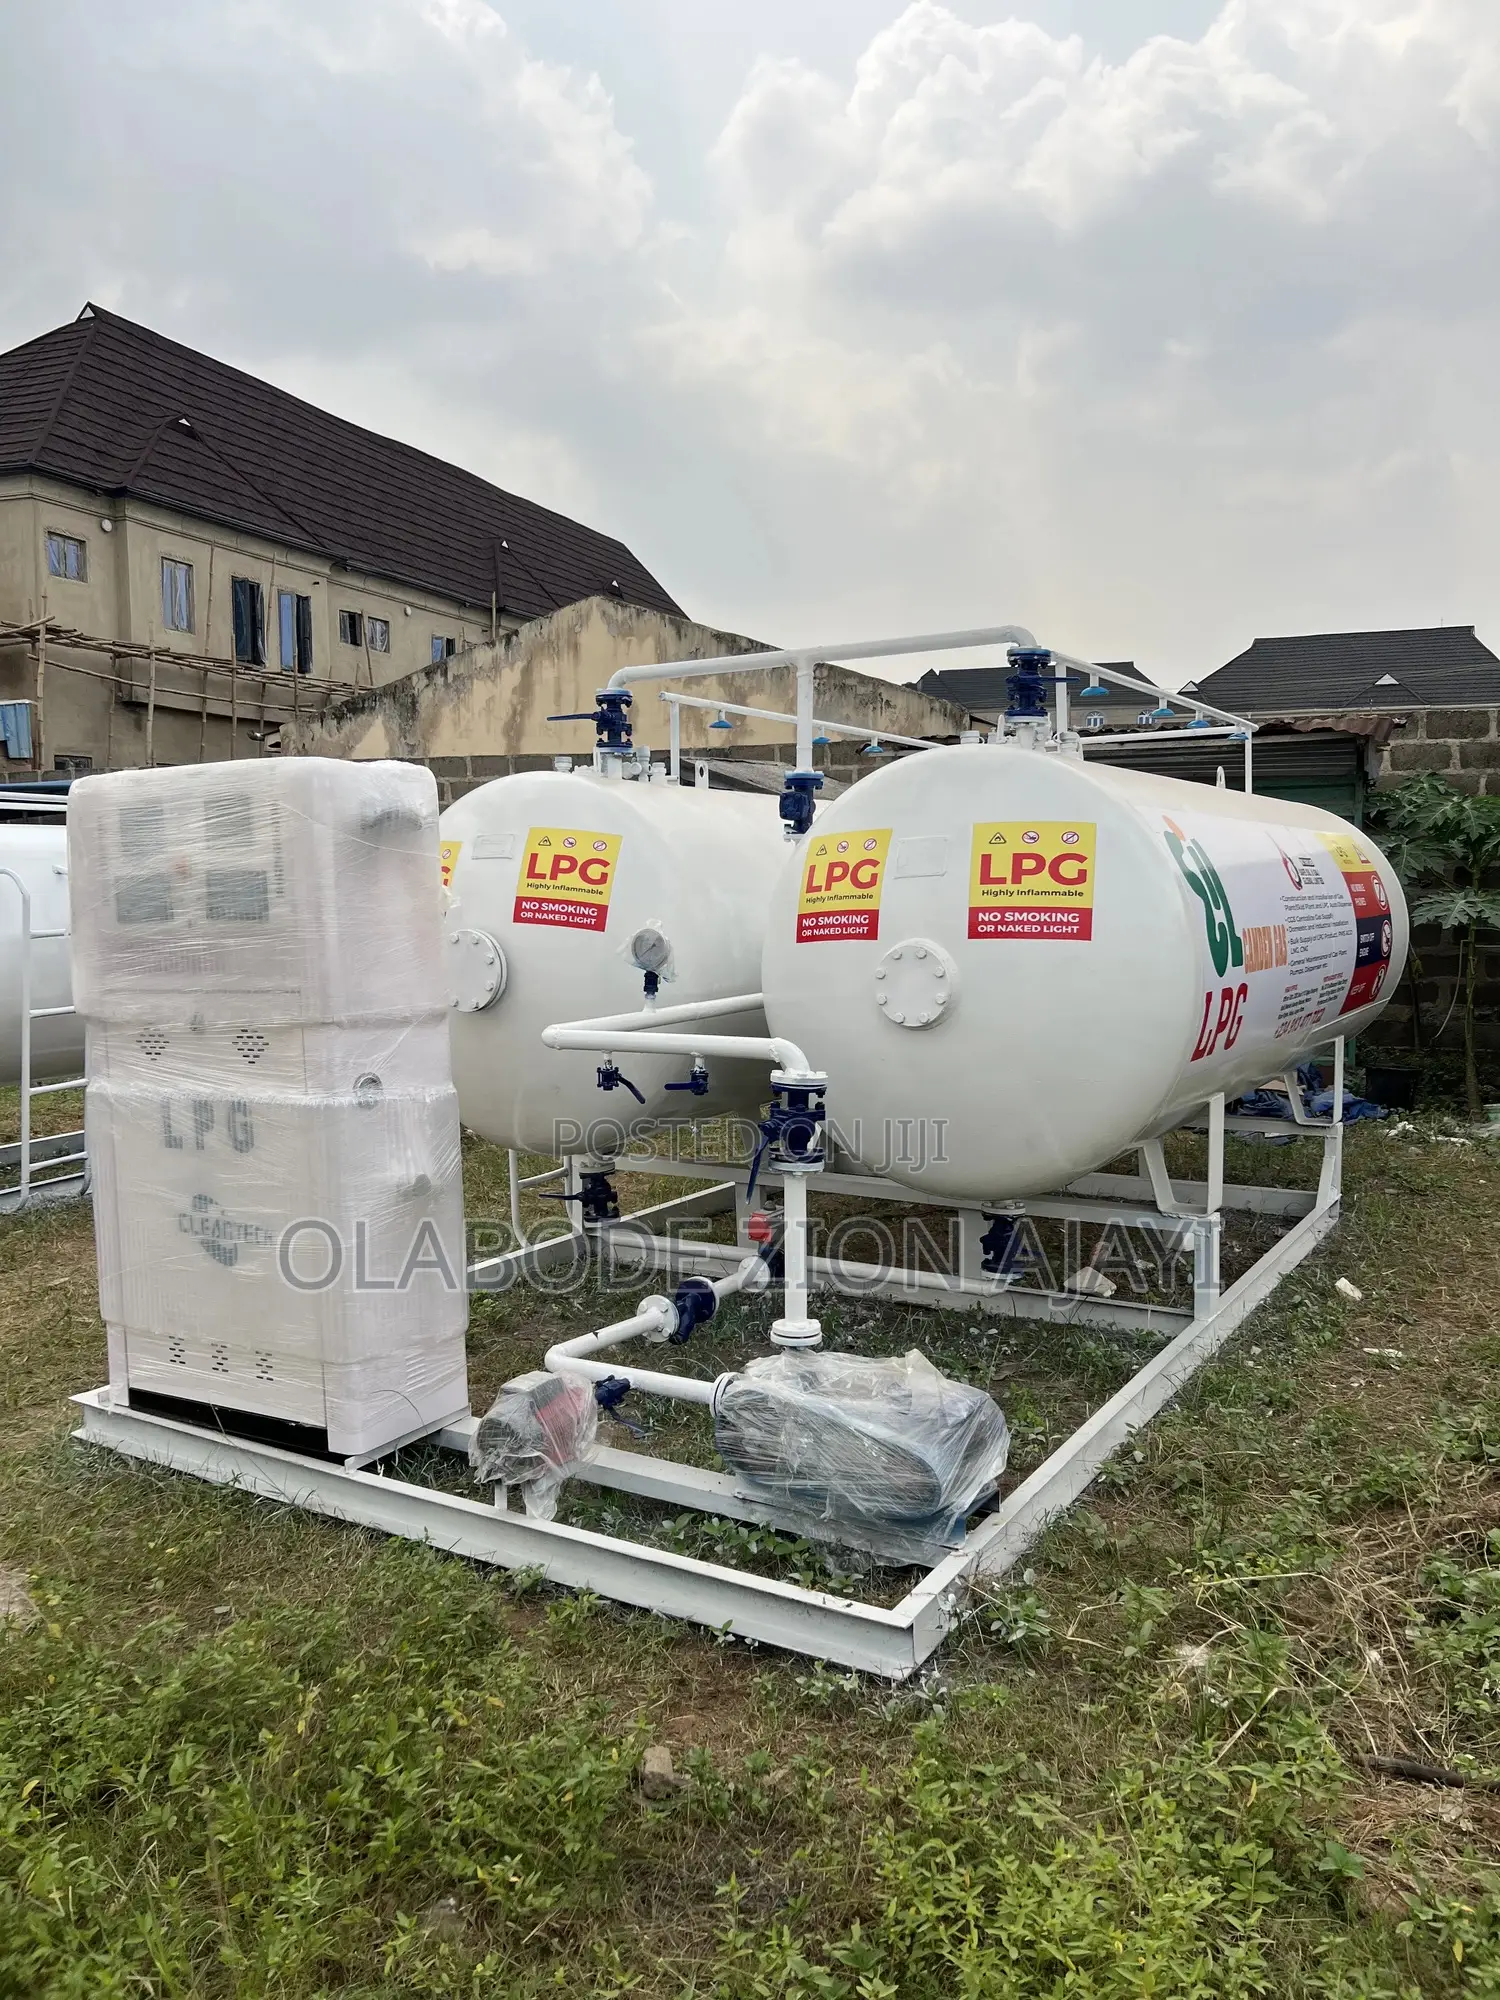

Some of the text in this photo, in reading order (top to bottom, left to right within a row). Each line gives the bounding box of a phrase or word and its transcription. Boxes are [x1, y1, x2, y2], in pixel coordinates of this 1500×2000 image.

[526, 853, 611, 886] LPG
[805, 858, 881, 894] LPG
[979, 852, 1089, 886] LPG
[527, 882, 604, 896] Highly Inflammable
[981, 889, 1085, 897] Highly Inflammable
[806, 893, 874, 904] Highly Inflammable
[521, 901, 598, 917] NO SMOKING
[520, 911, 596, 925] OR NAKED LIGHT
[802, 914, 869, 927] NO SMOKING
[978, 912, 1080, 923] NO SMOKING
[977, 925, 995, 933] OR
[997, 924, 1041, 933] NAKED
[1190, 982, 1248, 1062] LPG
[160, 1098, 255, 1153] LPG
